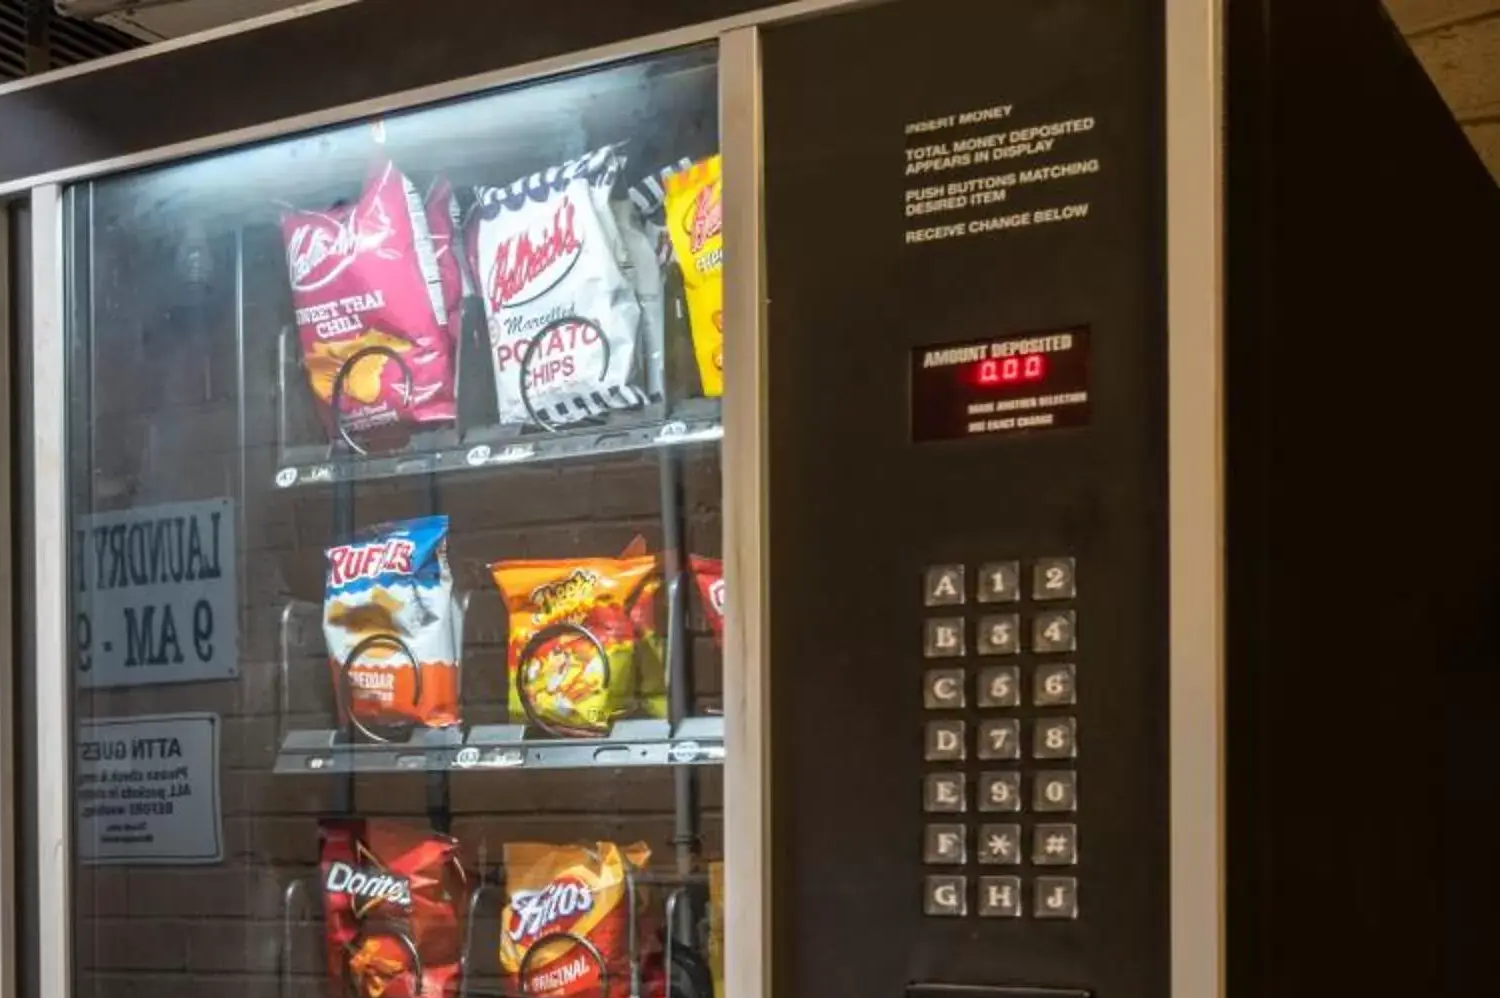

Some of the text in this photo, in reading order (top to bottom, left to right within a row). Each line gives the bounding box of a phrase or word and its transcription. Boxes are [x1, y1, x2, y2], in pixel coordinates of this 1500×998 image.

[905, 104, 1013, 134] INSERT MONEY
[905, 117, 1095, 161] TOTAL MONEY DEPOSITED
[905, 138, 1055, 175] APPEARS IN DISPLAY
[905, 159, 1099, 202] PUSH BUTTONS MATCHING
[905, 189, 1007, 217] DESIRED ITEM
[905, 203, 1089, 244] RECEIVE CHANGE BELOW
[296, 300, 340, 327] WEET
[923, 334, 1073, 368] AMOUNT DEPOSITED
[933, 567, 1064, 597] A 1 2
[1043, 619, 1063, 642] 4
[349, 671, 395, 690] HEDDAR
[933, 677, 957, 699] C
[1044, 673, 1065, 695] 6
[937, 727, 1064, 751] D 7 8
[936, 780, 1064, 803] E 9 0
[937, 833, 959, 854] F
[934, 885, 1065, 908] G H J
